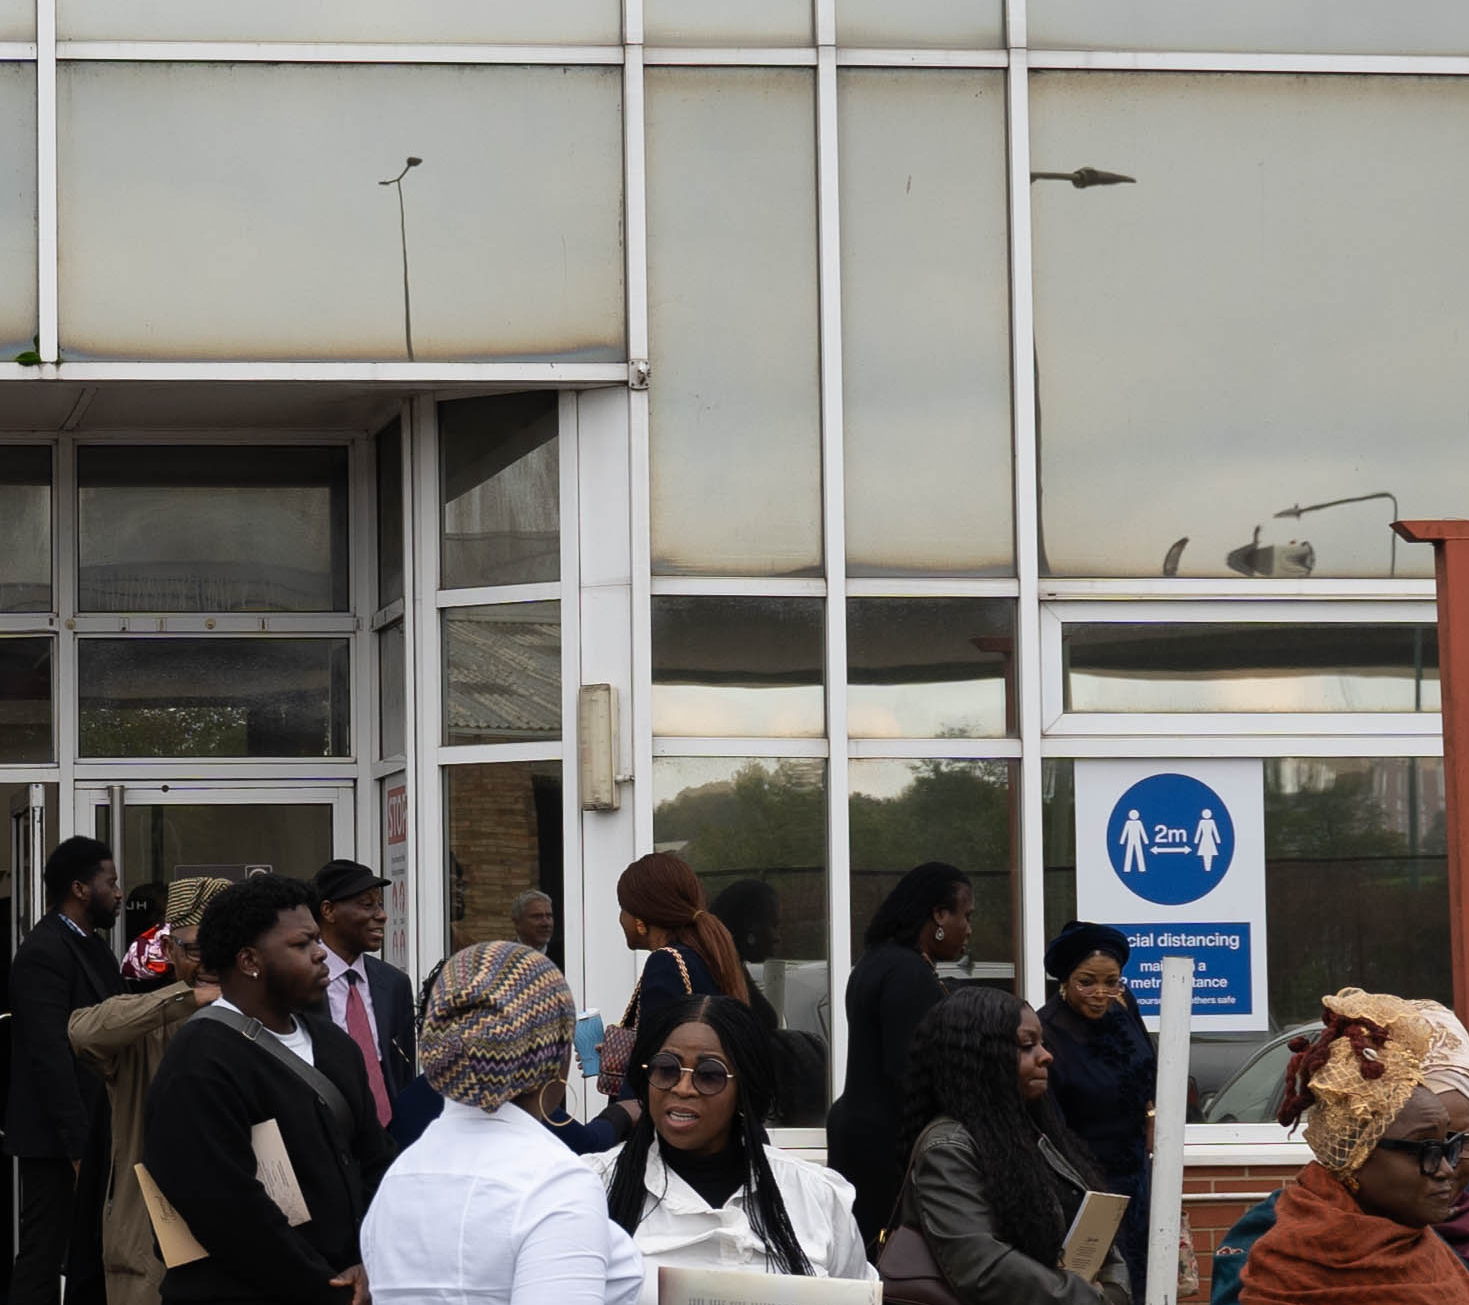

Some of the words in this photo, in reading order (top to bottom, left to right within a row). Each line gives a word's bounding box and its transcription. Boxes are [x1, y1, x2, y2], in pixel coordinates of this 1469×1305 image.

[1155, 825, 1187, 843] 2m
[1127, 933, 1154, 948] cial
[1157, 932, 1240, 950] distancing
[1198, 962, 1207, 972] a
[1130, 977, 1162, 989] metr
[1192, 976, 1228, 988] tance
[1218, 996, 1236, 1005] safe
